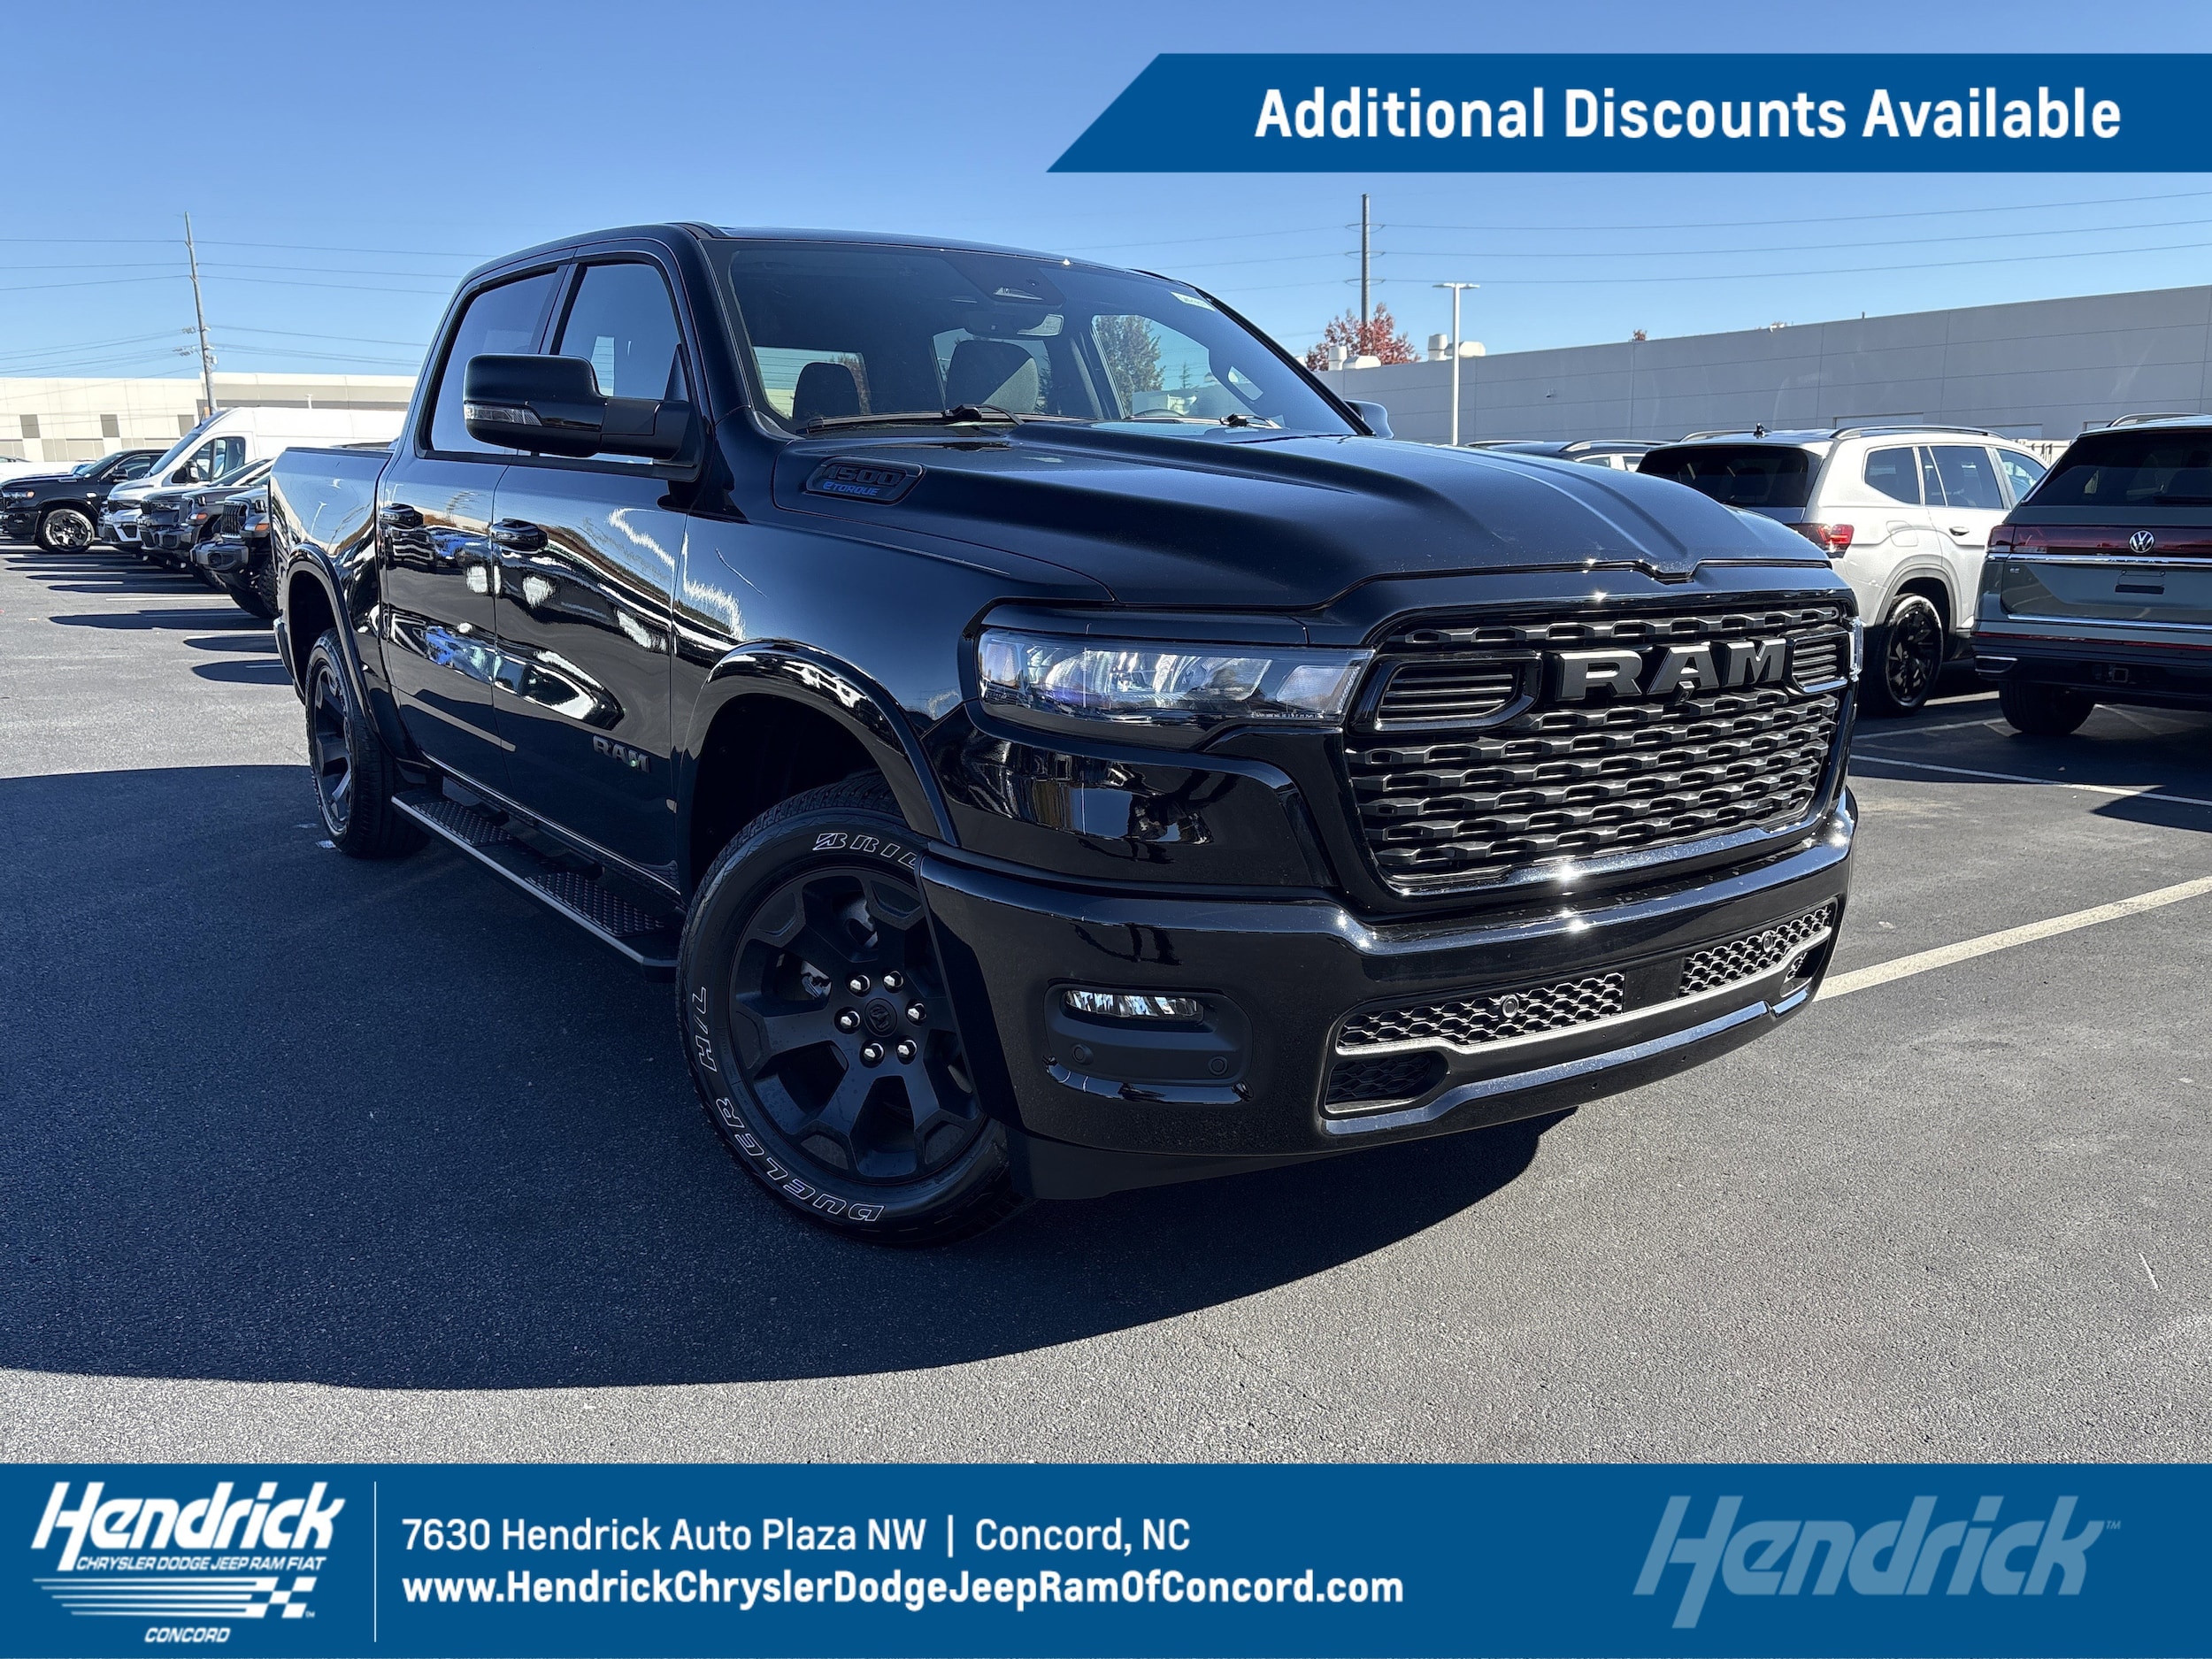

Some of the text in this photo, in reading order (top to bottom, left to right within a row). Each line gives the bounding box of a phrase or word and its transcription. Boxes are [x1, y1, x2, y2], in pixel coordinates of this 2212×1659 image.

[825, 465, 902, 486] 1500
[1555, 635, 1788, 703] RAM
[592, 734, 651, 773] RAM
[715, 1097, 885, 1222] DUELER
